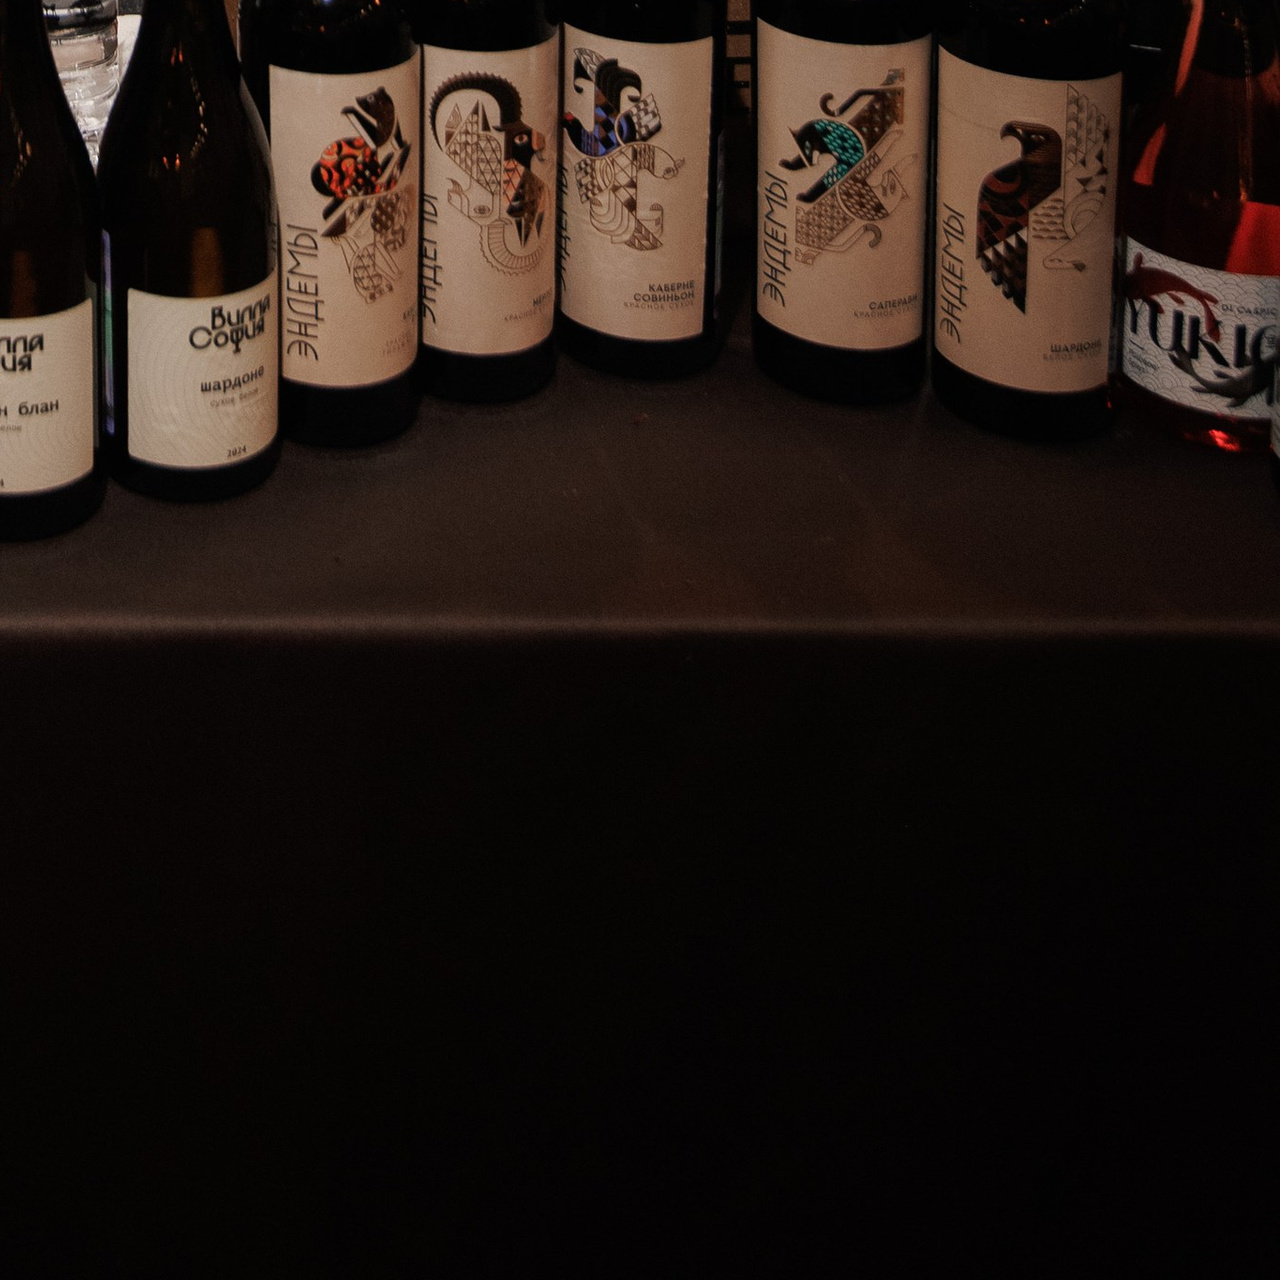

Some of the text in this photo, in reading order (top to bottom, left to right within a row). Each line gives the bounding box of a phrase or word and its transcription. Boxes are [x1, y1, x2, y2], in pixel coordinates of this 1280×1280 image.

[762, 170, 792, 308] ЭНДЕМЫ
[940, 202, 968, 344] ЭНДЕМЫ
[286, 223, 325, 362] ЭНДЕМЫ
[648, 280, 695, 292] КАБЕРНЕ
[633, 290, 695, 302] СОВИНЬОН
[868, 293, 918, 310] САПЕРАВИ
[1050, 339, 1102, 353] ШАРДОНЕ
[200, 365, 265, 394] шардоне
[18, 399, 59, 416] блан
